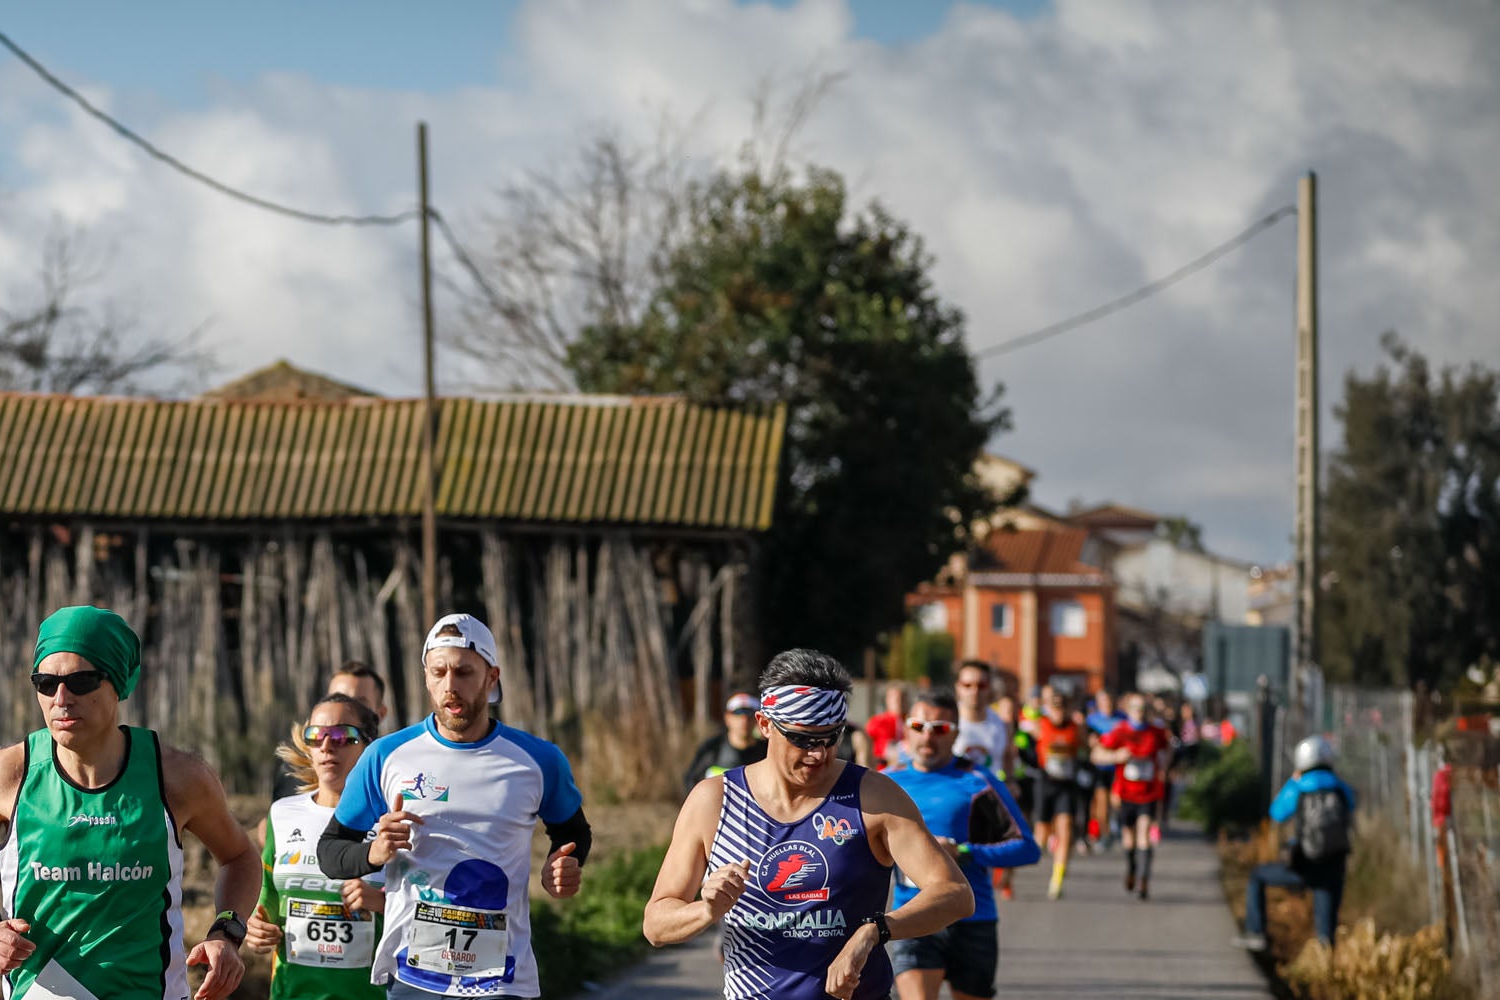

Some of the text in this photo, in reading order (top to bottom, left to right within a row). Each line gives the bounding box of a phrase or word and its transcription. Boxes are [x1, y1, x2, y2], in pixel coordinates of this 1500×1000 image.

[303, 854, 316, 865] IB
[762, 844, 816, 876] C.A. HUELLAS BLAL
[31, 860, 153, 881] Team Halcón
[442, 908, 477, 918] CARRERA
[442, 914, 476, 922] POPULAR
[744, 909, 847, 930] SONRIALIA
[307, 921, 354, 944] 653
[783, 927, 813, 938] CLÍNICA
[445, 928, 478, 951] 17
[318, 943, 343, 954] GLORIA
[441, 950, 477, 962] GERARDO
